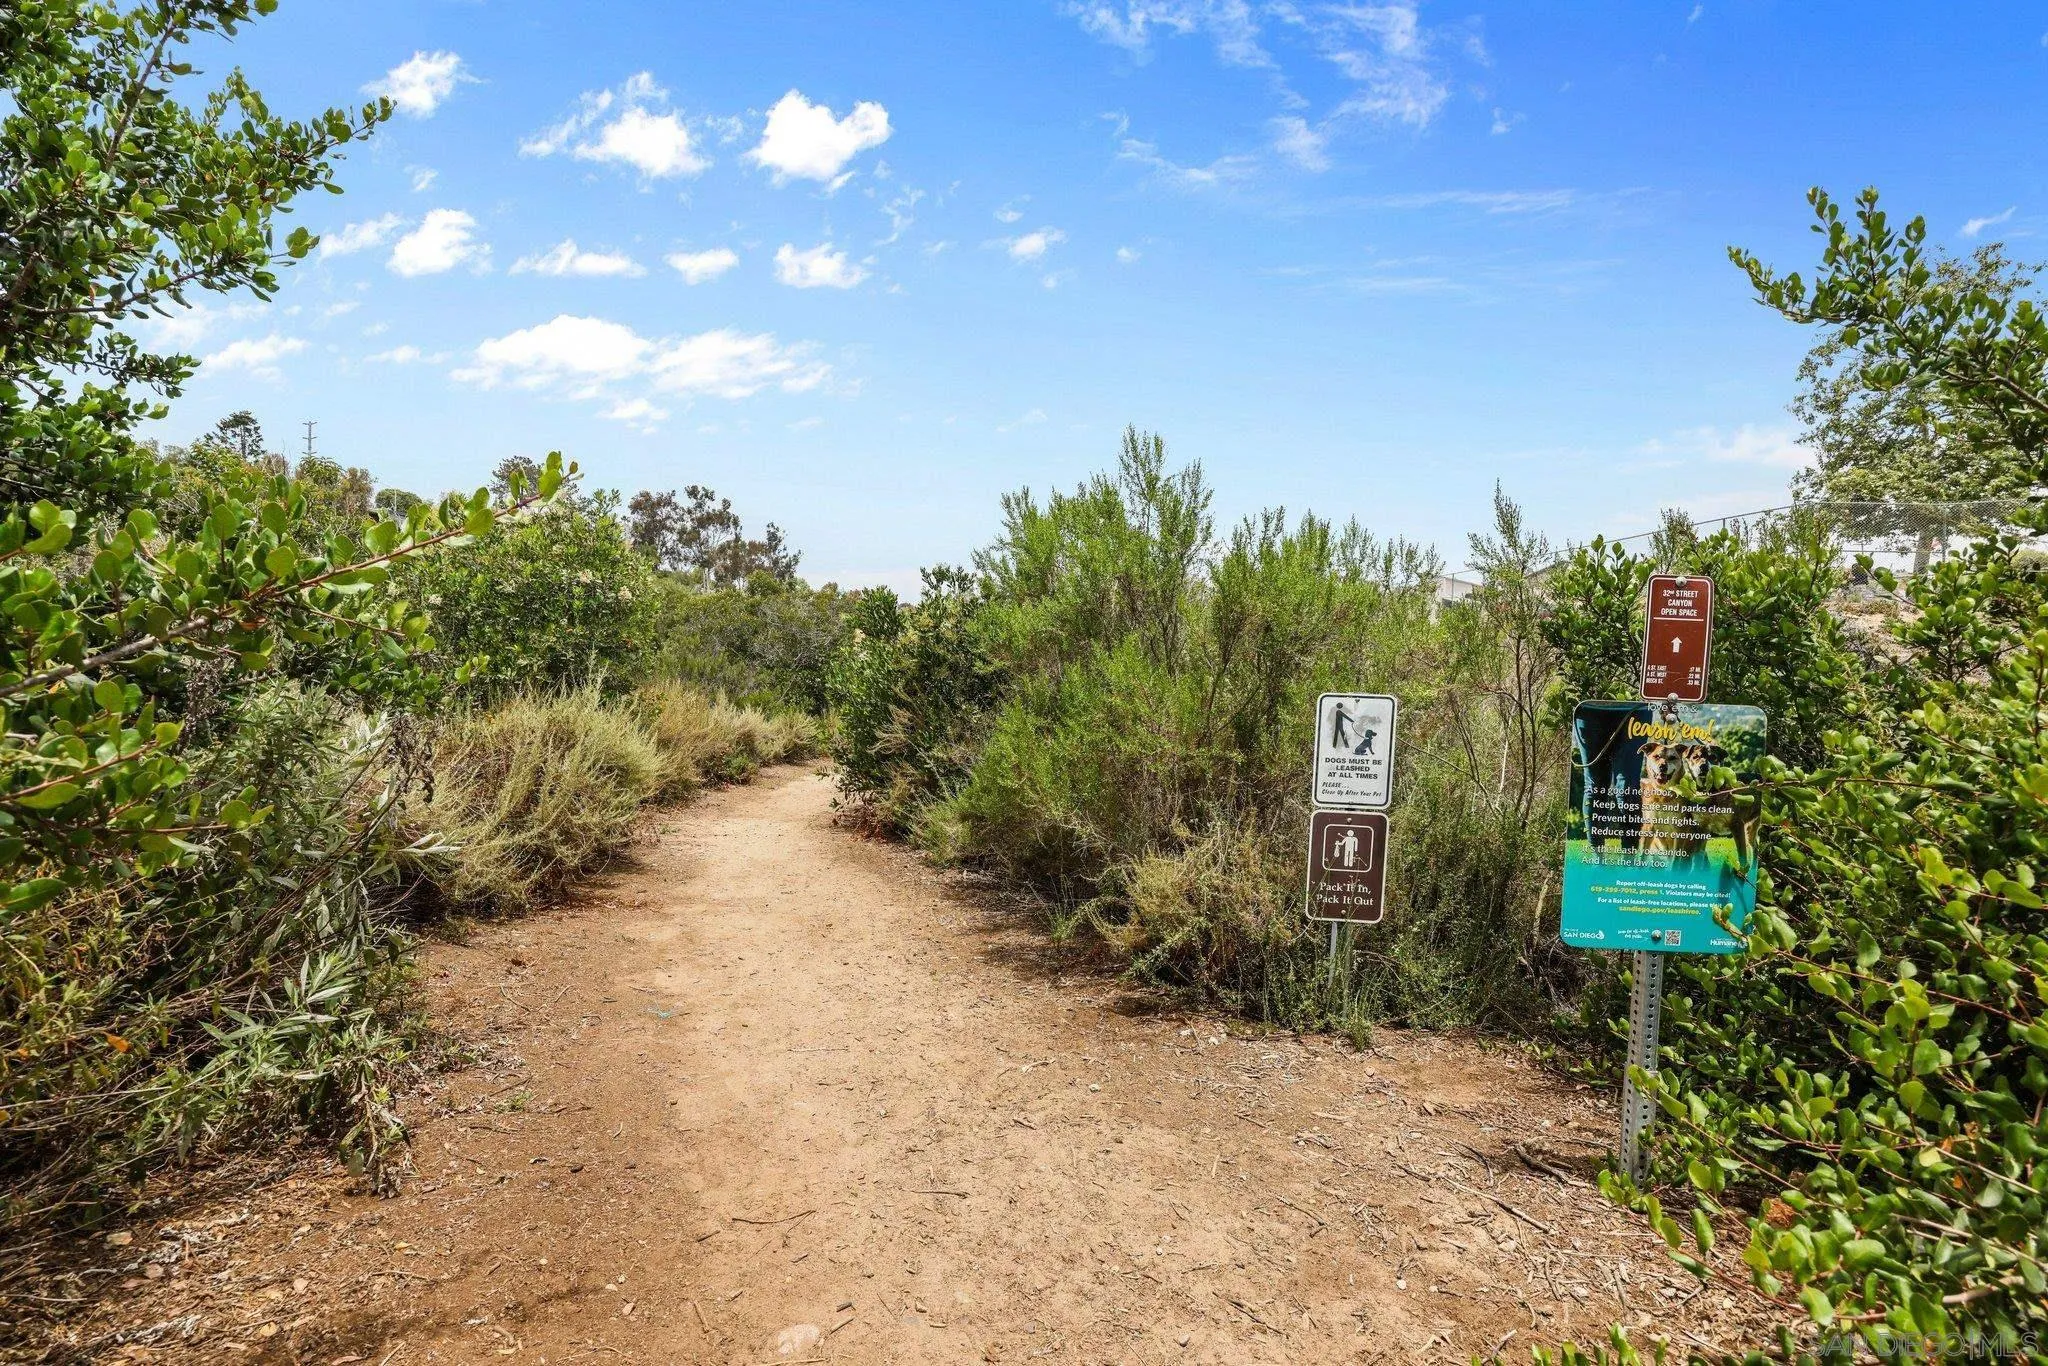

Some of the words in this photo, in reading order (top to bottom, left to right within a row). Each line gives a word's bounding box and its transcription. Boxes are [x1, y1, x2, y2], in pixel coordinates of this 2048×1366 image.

[1675, 589, 1699, 598] STREET
[1667, 598, 1693, 607] CANYON
[1660, 607, 1677, 616] OPEN
[1678, 608, 1698, 617] SPACE
[1628, 717, 1677, 740] leash
[1679, 718, 1716, 742] 'em!
[1355, 772, 1378, 780] TIMES
[1607, 787, 1630, 796] good
[1592, 799, 1616, 810] Keep
[1617, 802, 1640, 811] dogs
[1662, 803, 1679, 812] and
[1681, 803, 1707, 813] parks
[1708, 805, 1735, 814] clean.
[1592, 812, 1627, 823] Prevent
[1628, 814, 1650, 824] bites
[1652, 816, 1670, 824] and
[1671, 817, 1700, 827] fights.
[1591, 826, 1624, 836] Reduce
[1625, 828, 1654, 838] stress
[1656, 830, 1669, 838] for
[1614, 845, 1637, 855] leash
[1675, 848, 1690, 857] do.
[1581, 856, 1600, 865] And
[1601, 857, 1616, 866] it's
[1617, 858, 1632, 866] the
[1633, 858, 1649, 867] law
[1651, 860, 1668, 868] too.
[1319, 882, 1342, 891] Pack
[1347, 884, 1355, 892] It
[1357, 884, 1372, 894] In,
[1679, 882, 1686, 890] by
[1665, 889, 1692, 897] Violators
[1317, 894, 1339, 903] Pack
[1343, 896, 1352, 904] It
[1354, 896, 1374, 906] Out
[1630, 898, 1660, 906] leash-free
[1579, 931, 1604, 939] DIEGO
